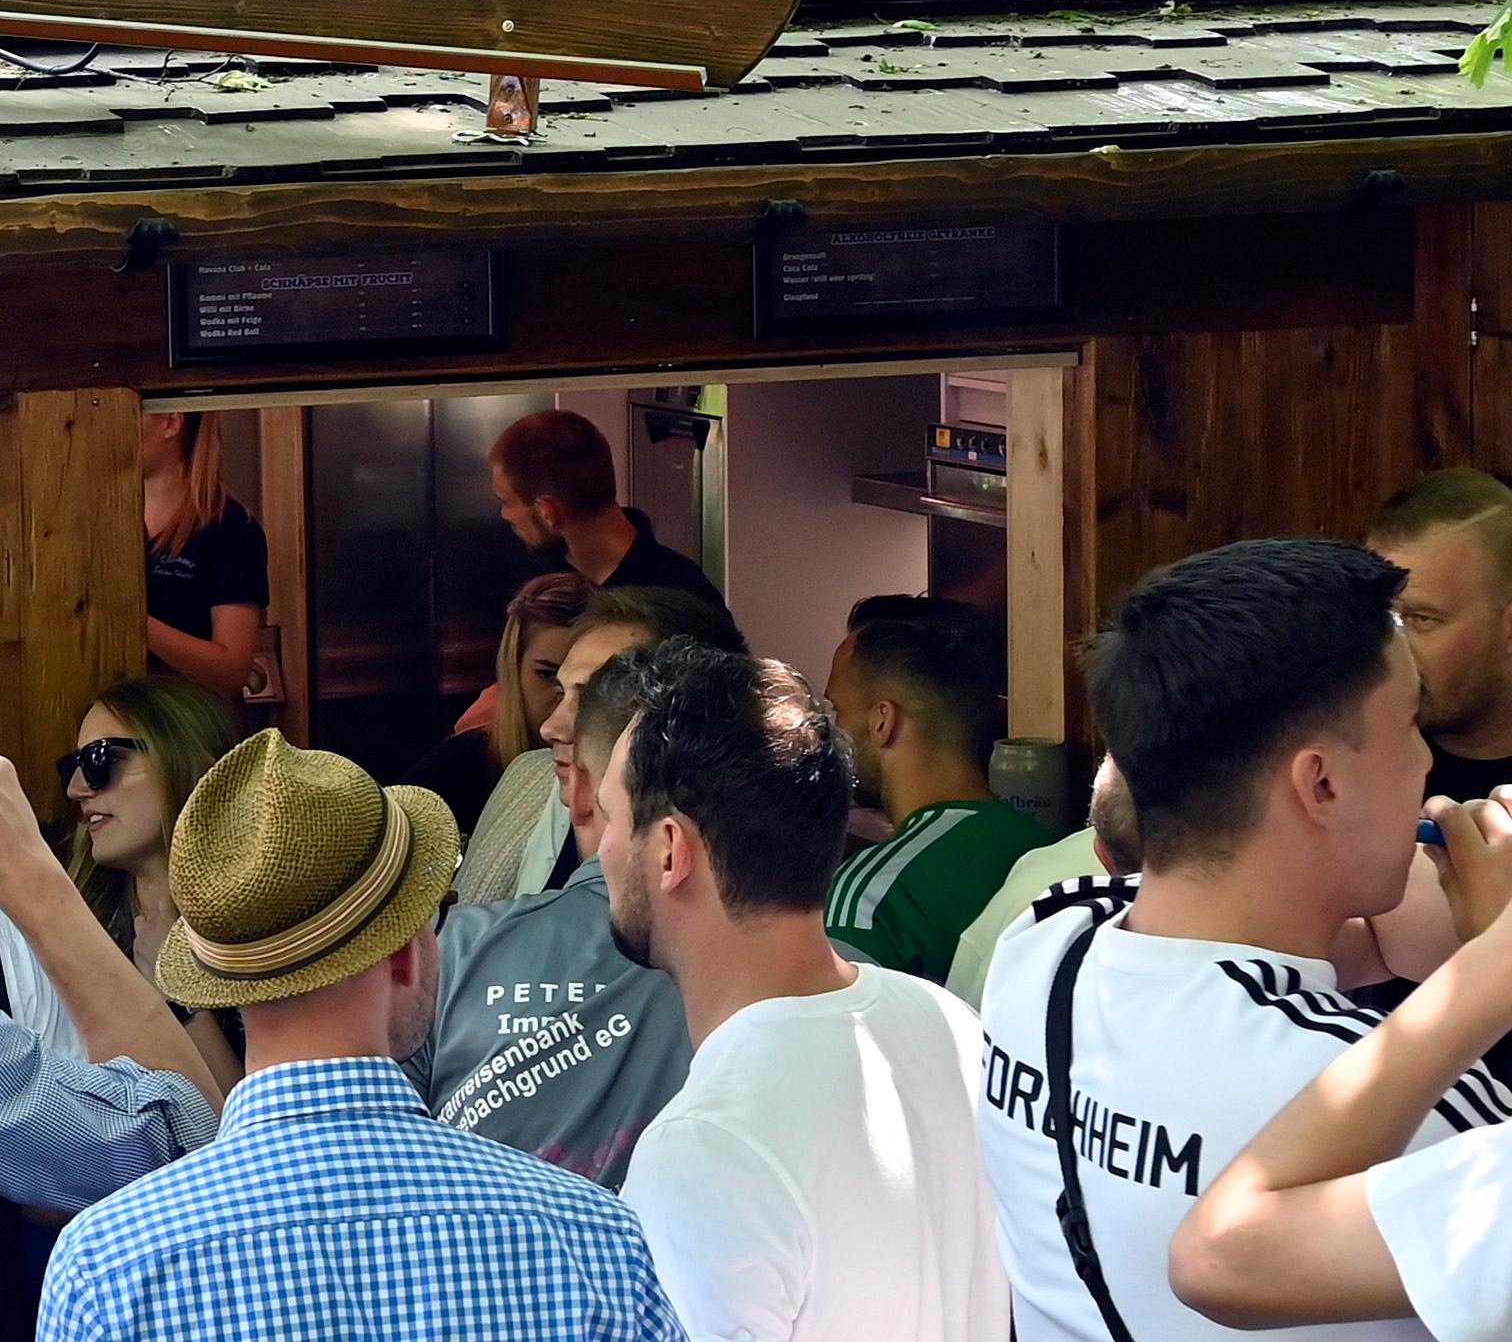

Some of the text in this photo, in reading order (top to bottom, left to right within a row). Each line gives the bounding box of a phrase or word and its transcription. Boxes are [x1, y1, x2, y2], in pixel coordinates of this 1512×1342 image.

[262, 272, 414, 290] SCHNÄPSE MIT FRUCHT
